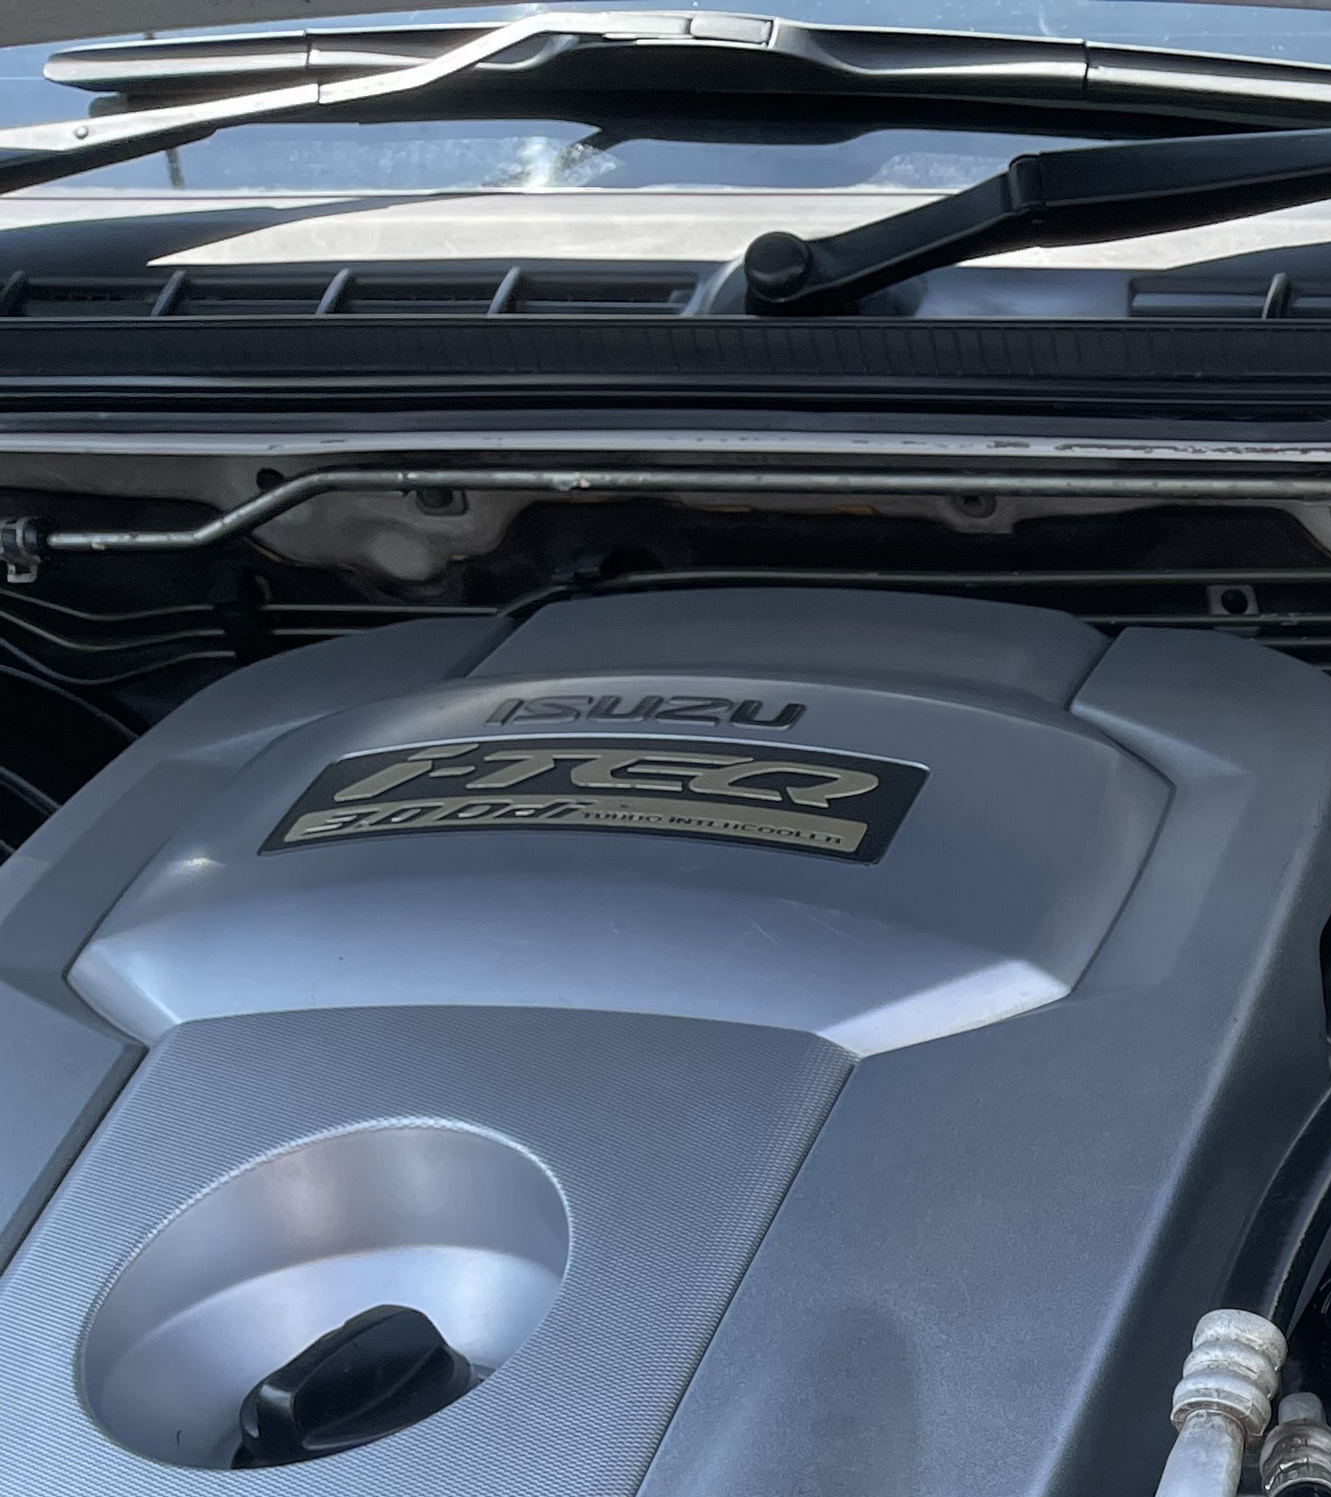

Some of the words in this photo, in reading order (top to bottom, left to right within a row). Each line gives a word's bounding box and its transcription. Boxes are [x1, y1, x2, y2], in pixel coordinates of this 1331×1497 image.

[485, 694, 807, 731] ISUZU
[335, 743, 880, 808] i-TEQ
[668, 814, 843, 845] INTERCOOLER
